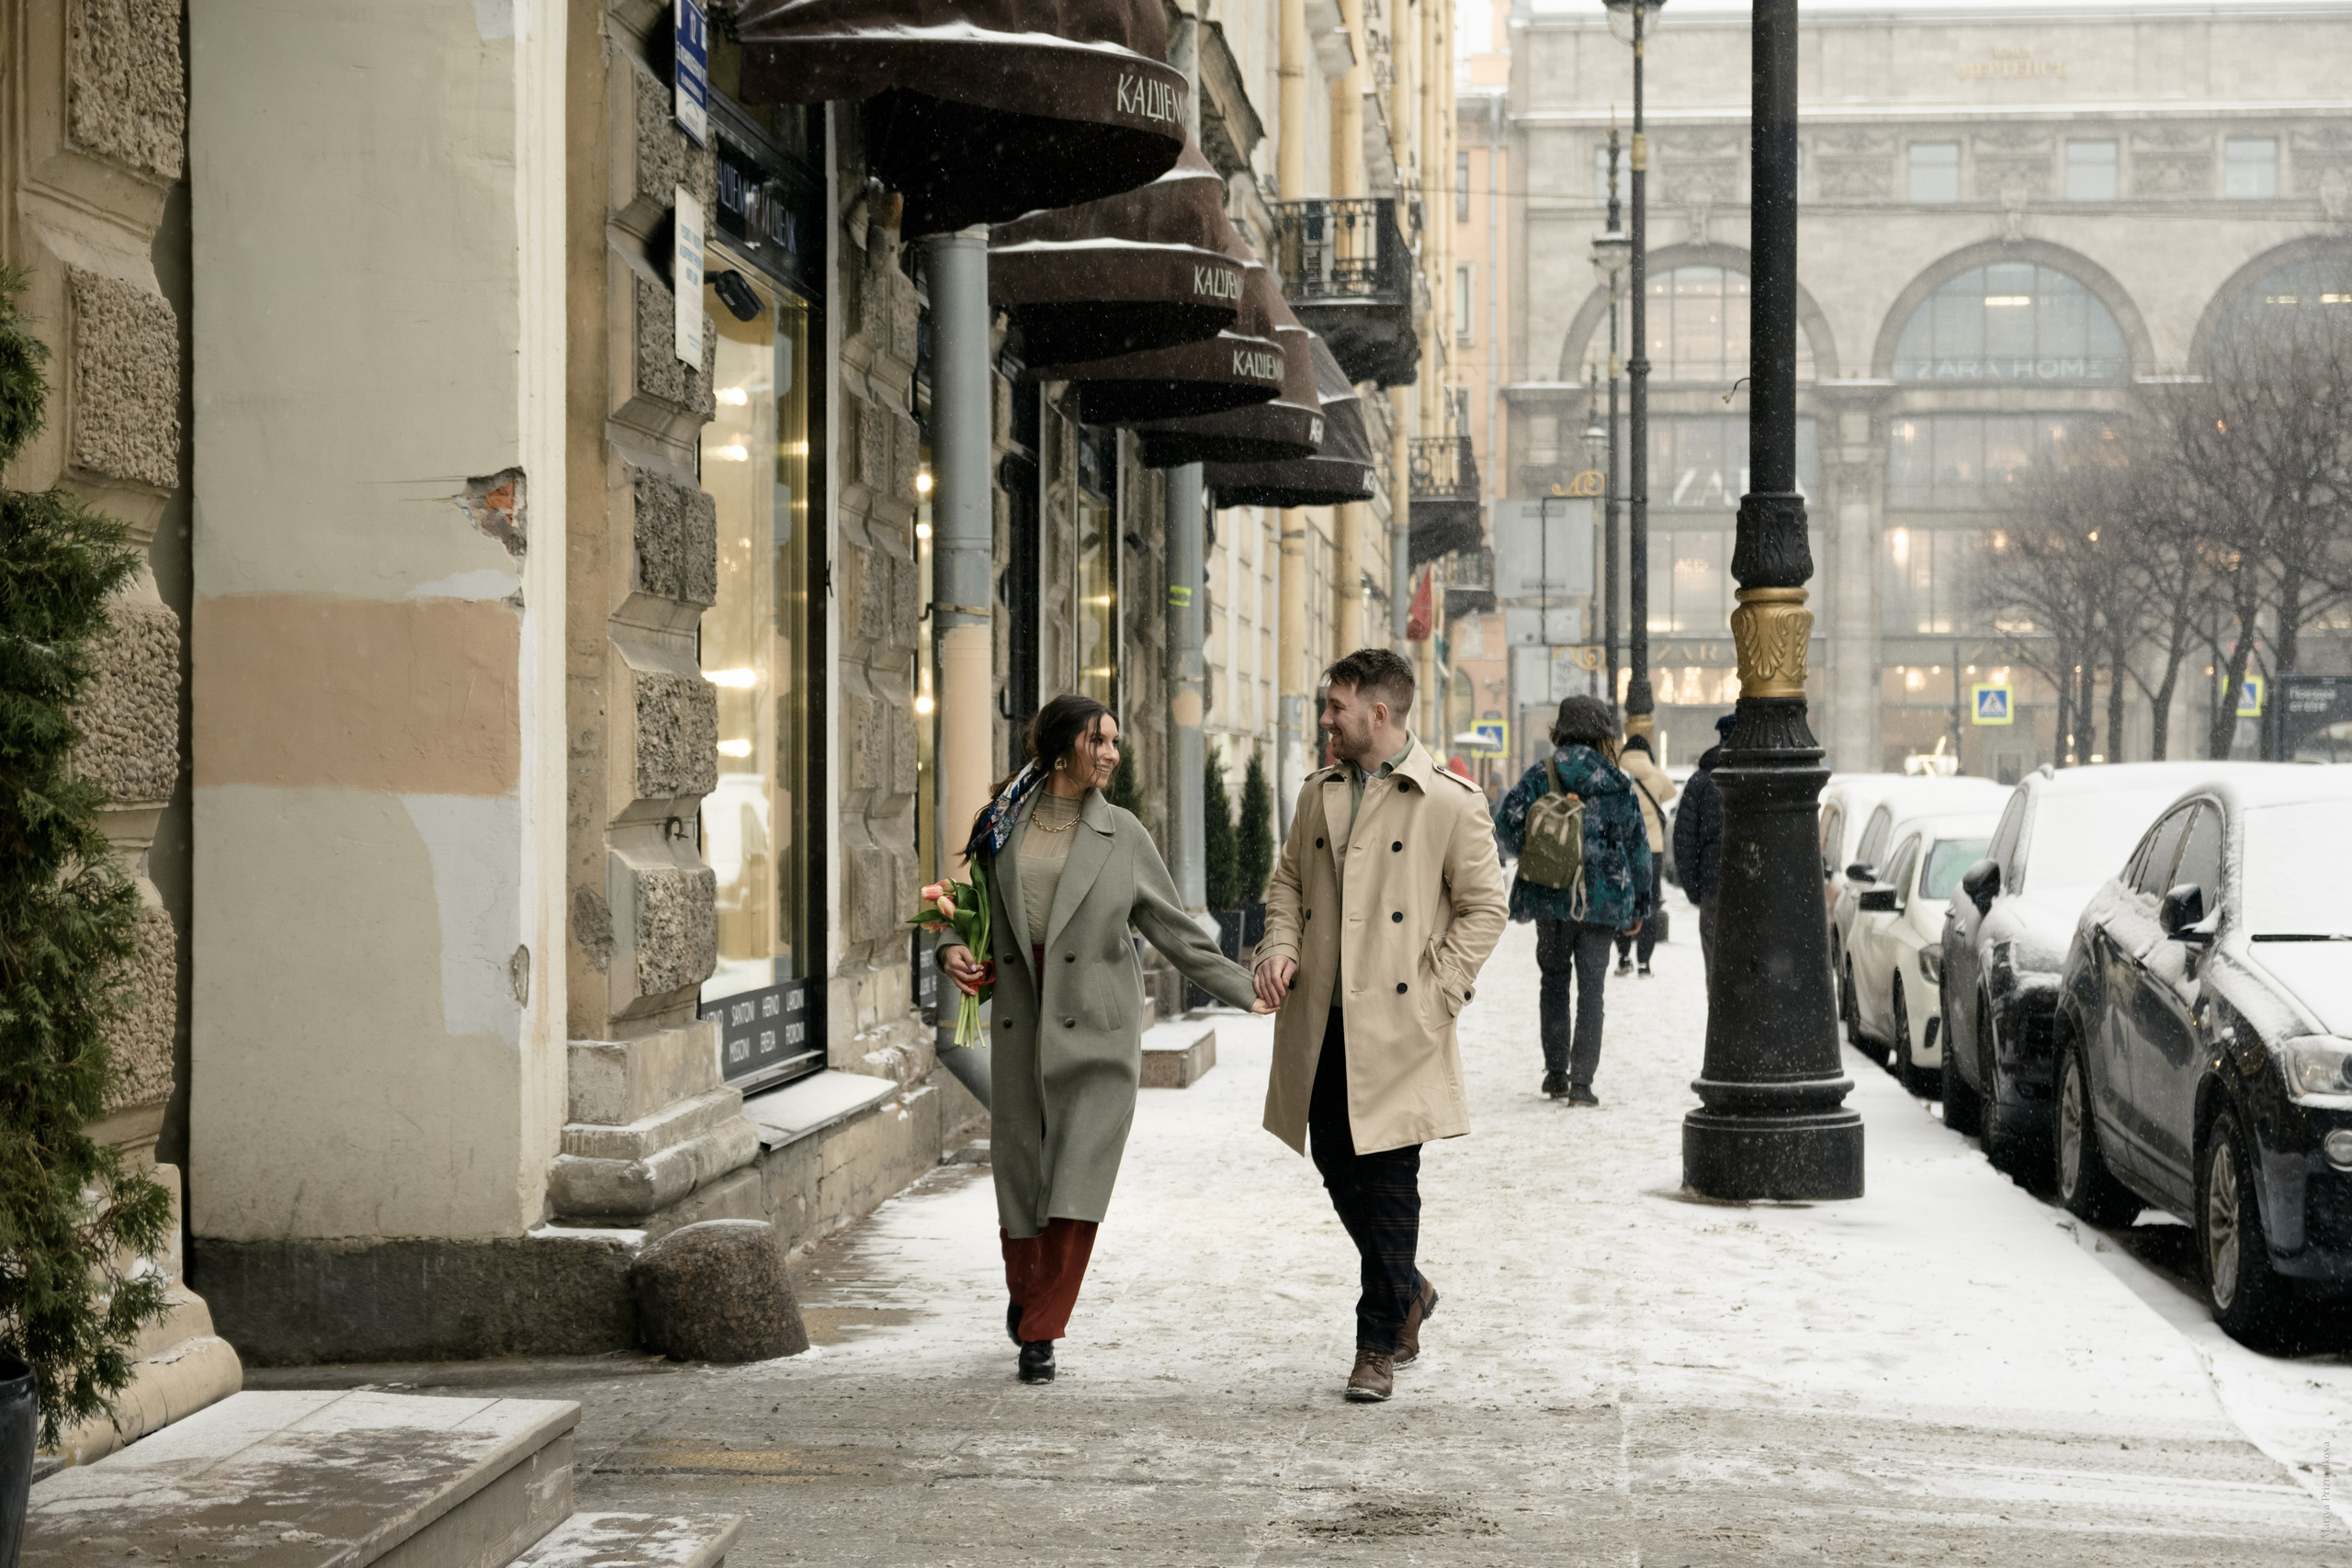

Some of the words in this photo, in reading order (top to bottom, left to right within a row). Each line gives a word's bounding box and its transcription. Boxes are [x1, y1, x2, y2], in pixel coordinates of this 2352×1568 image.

[717, 157, 761, 229] АШЕМИР
[1917, 359, 2002, 379] ZARA
[2013, 359, 2105, 379] HOME
